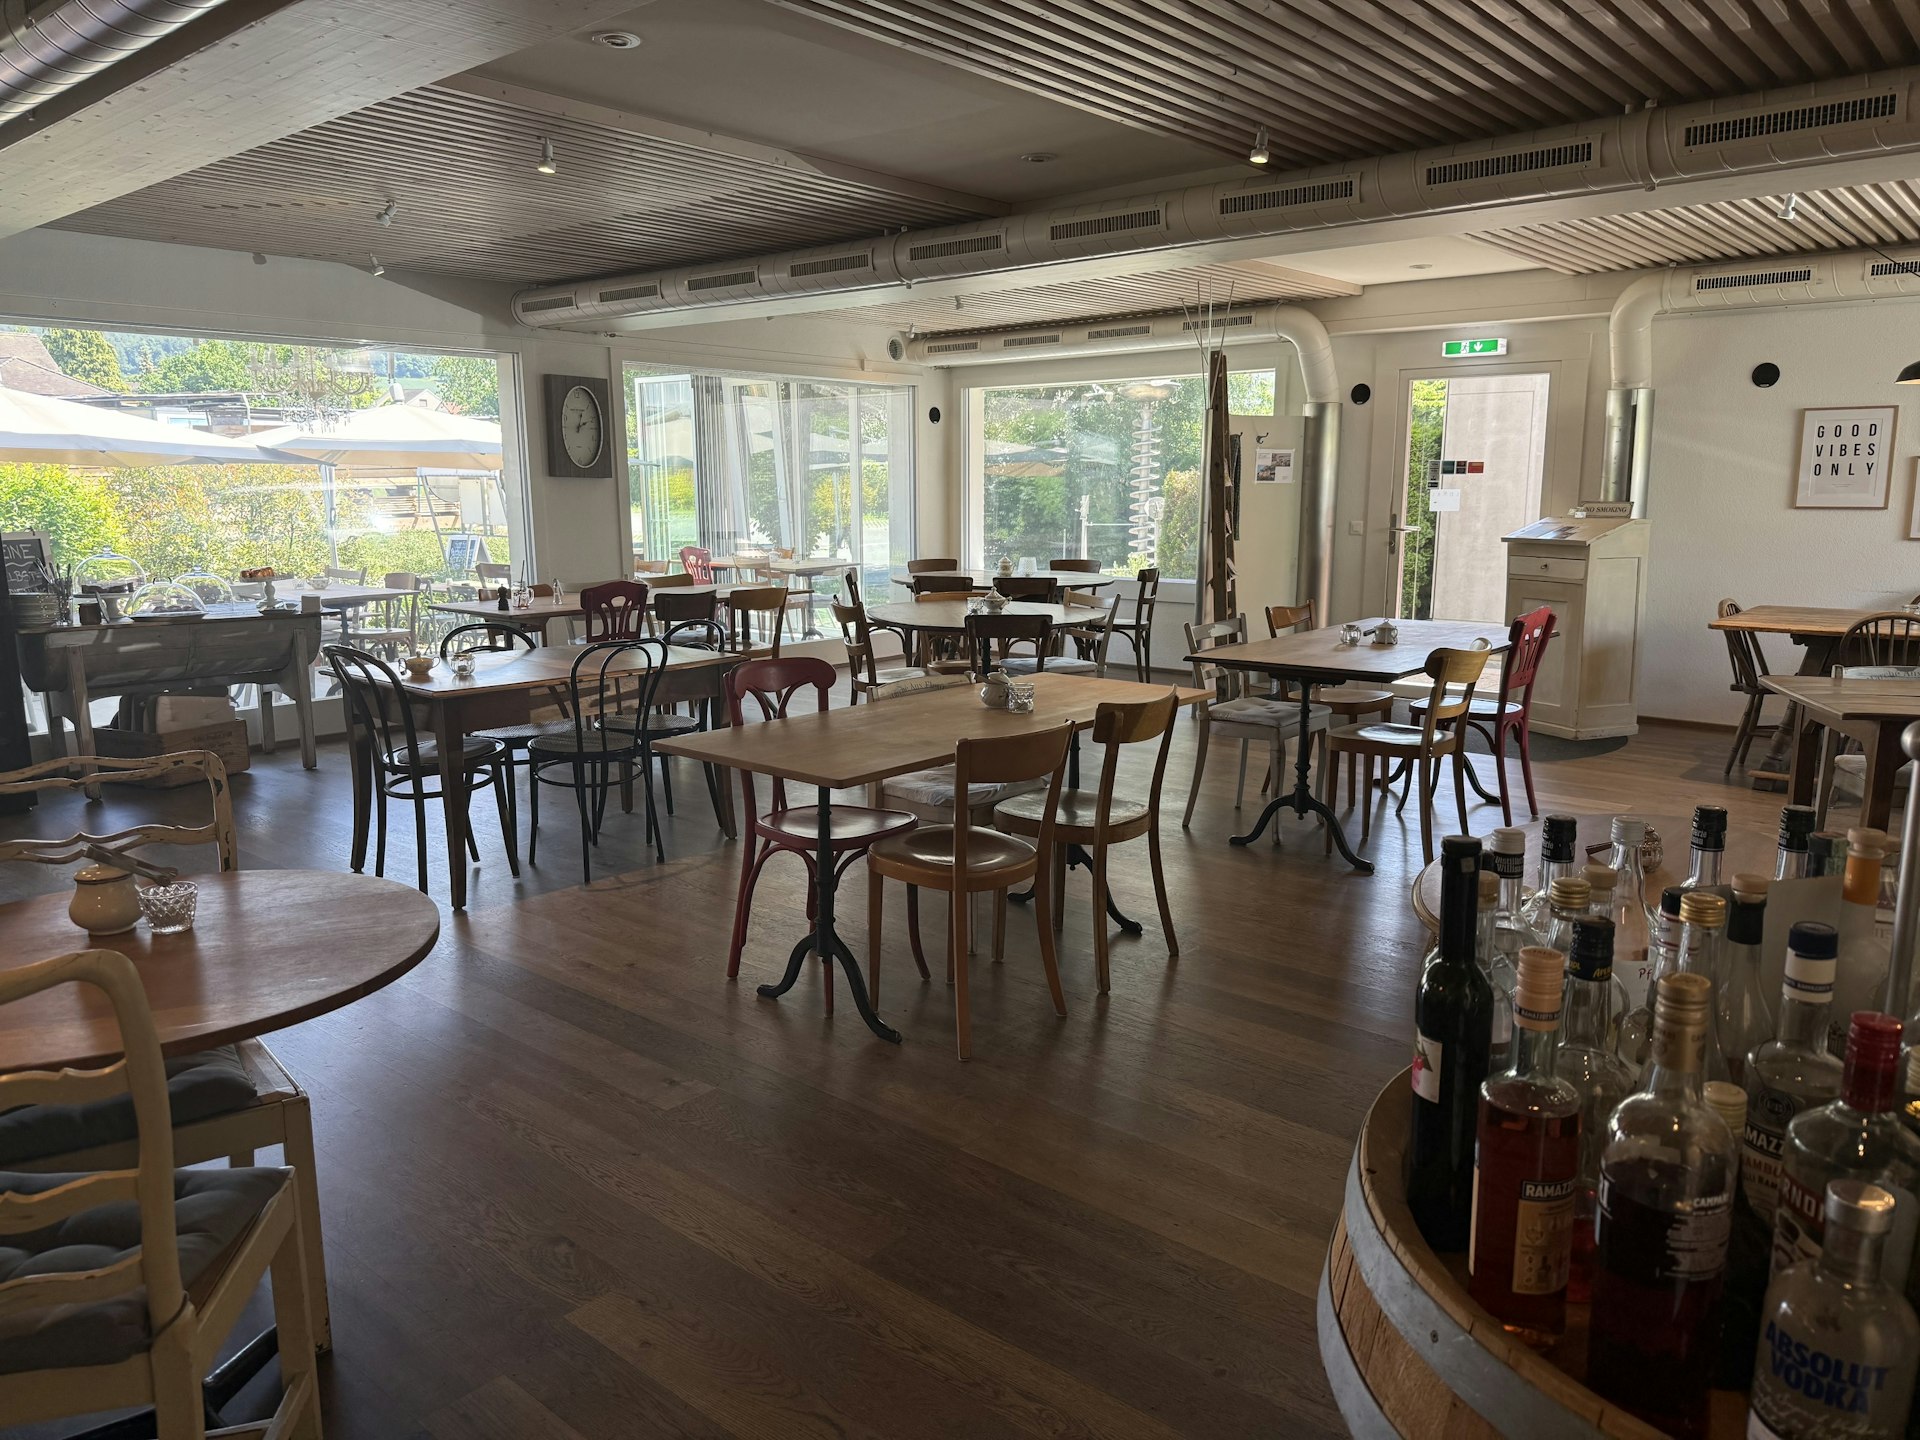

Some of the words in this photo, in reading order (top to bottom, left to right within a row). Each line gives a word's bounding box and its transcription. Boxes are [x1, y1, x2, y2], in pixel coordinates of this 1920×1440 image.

[1817, 423, 1877, 438] GOOD
[1815, 443, 1875, 457] VIBES
[1813, 462, 1874, 476] ONLY
[1765, 1319, 1889, 1391] ABSOLUT
[1770, 1348, 1869, 1415] VODKA
